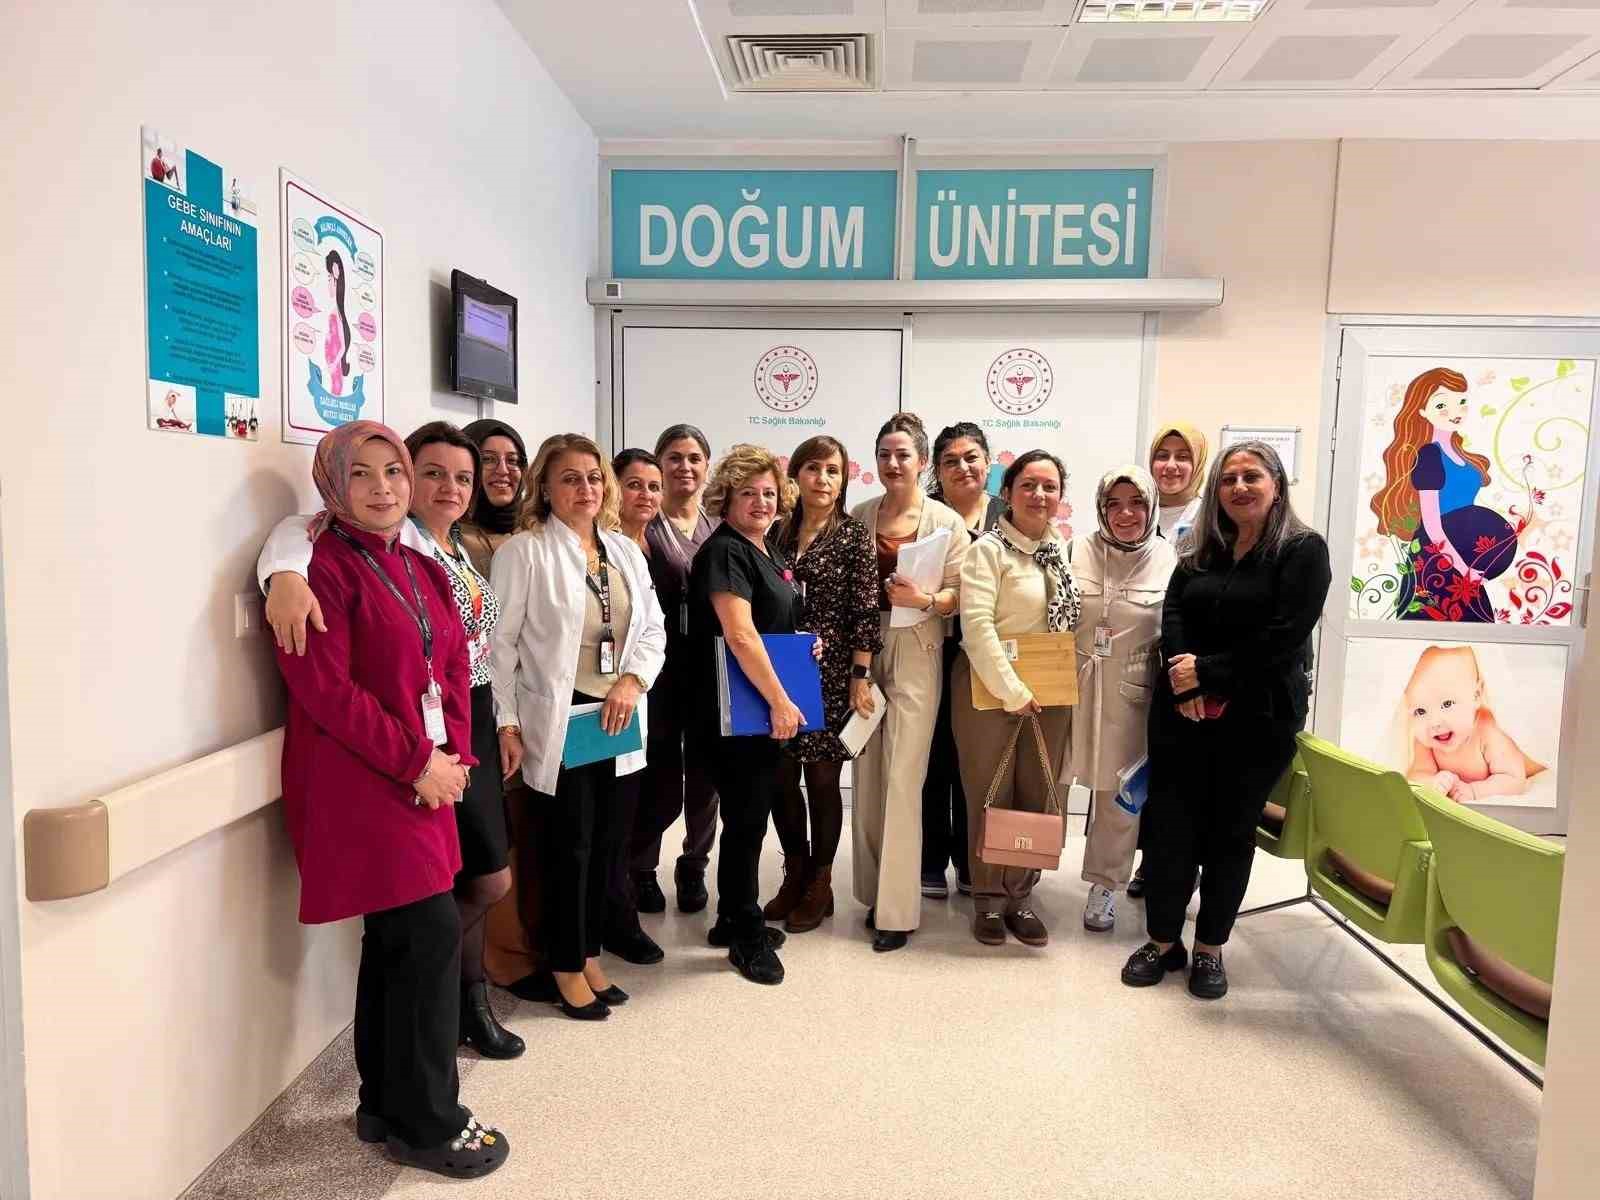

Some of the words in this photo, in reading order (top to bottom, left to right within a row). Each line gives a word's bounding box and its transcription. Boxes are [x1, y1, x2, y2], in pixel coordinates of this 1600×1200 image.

[167, 194, 197, 218] GEBE
[199, 207, 241, 237] SINIFININ
[180, 219, 232, 251] AMAÇLARI
[639, 188, 865, 269] DOĞUM
[928, 187, 1137, 267] ÜNİTESİ
